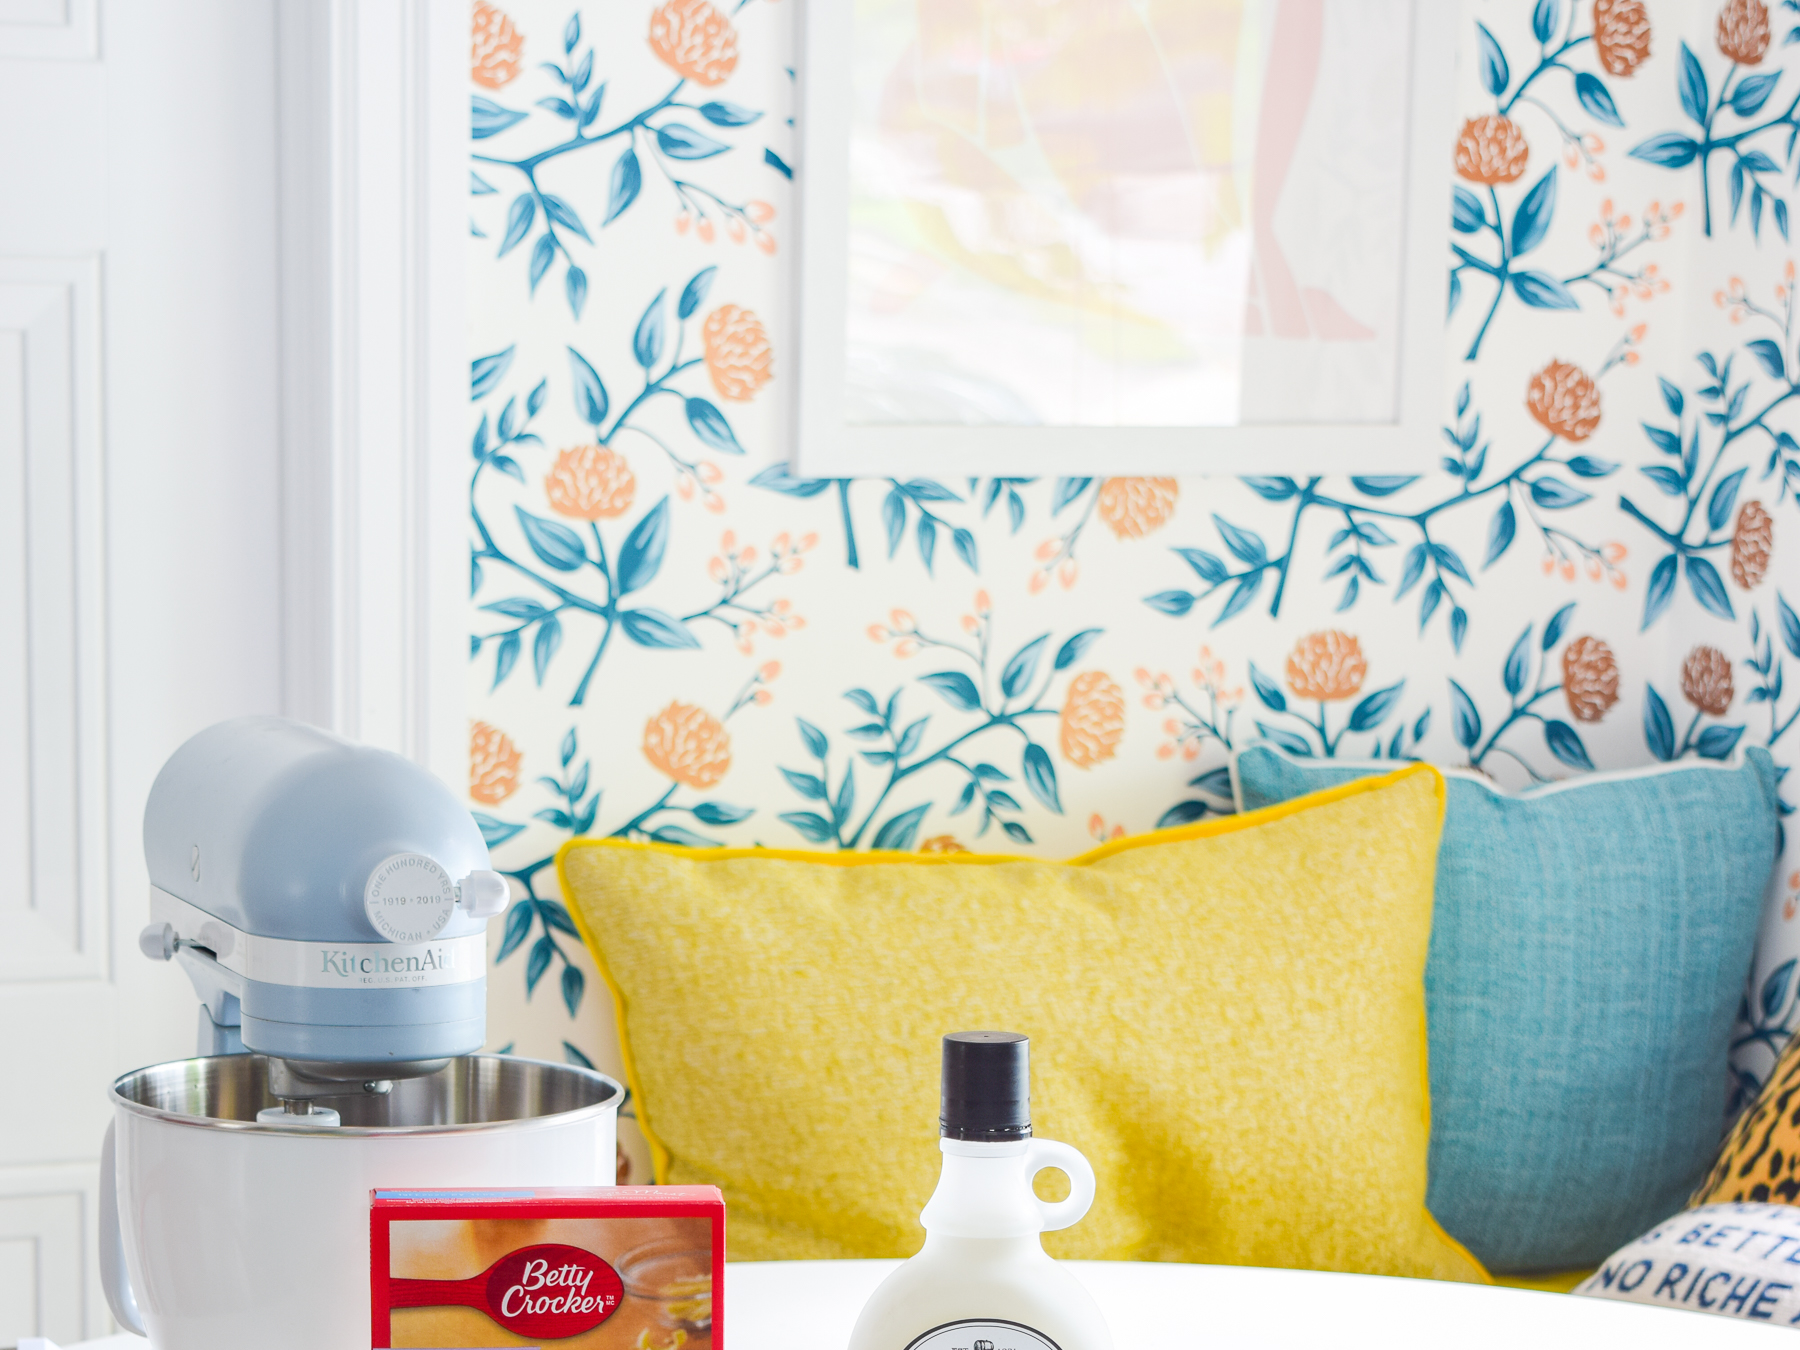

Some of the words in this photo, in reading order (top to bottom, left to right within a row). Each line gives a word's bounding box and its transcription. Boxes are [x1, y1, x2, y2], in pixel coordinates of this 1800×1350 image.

[371, 874, 387, 898] ONE
[384, 858, 438, 876] HUNDRED
[437, 871, 451, 895] YRS
[382, 897, 407, 906] 1919
[416, 895, 441, 904] 2019
[373, 910, 422, 942] MICHIGAN
[432, 908, 451, 931] USA
[522, 1259, 594, 1296] Betty
[1586, 1259, 1654, 1293] NO
[1654, 1262, 1800, 1323] RICHE
[501, 1285, 604, 1318] Crocker
